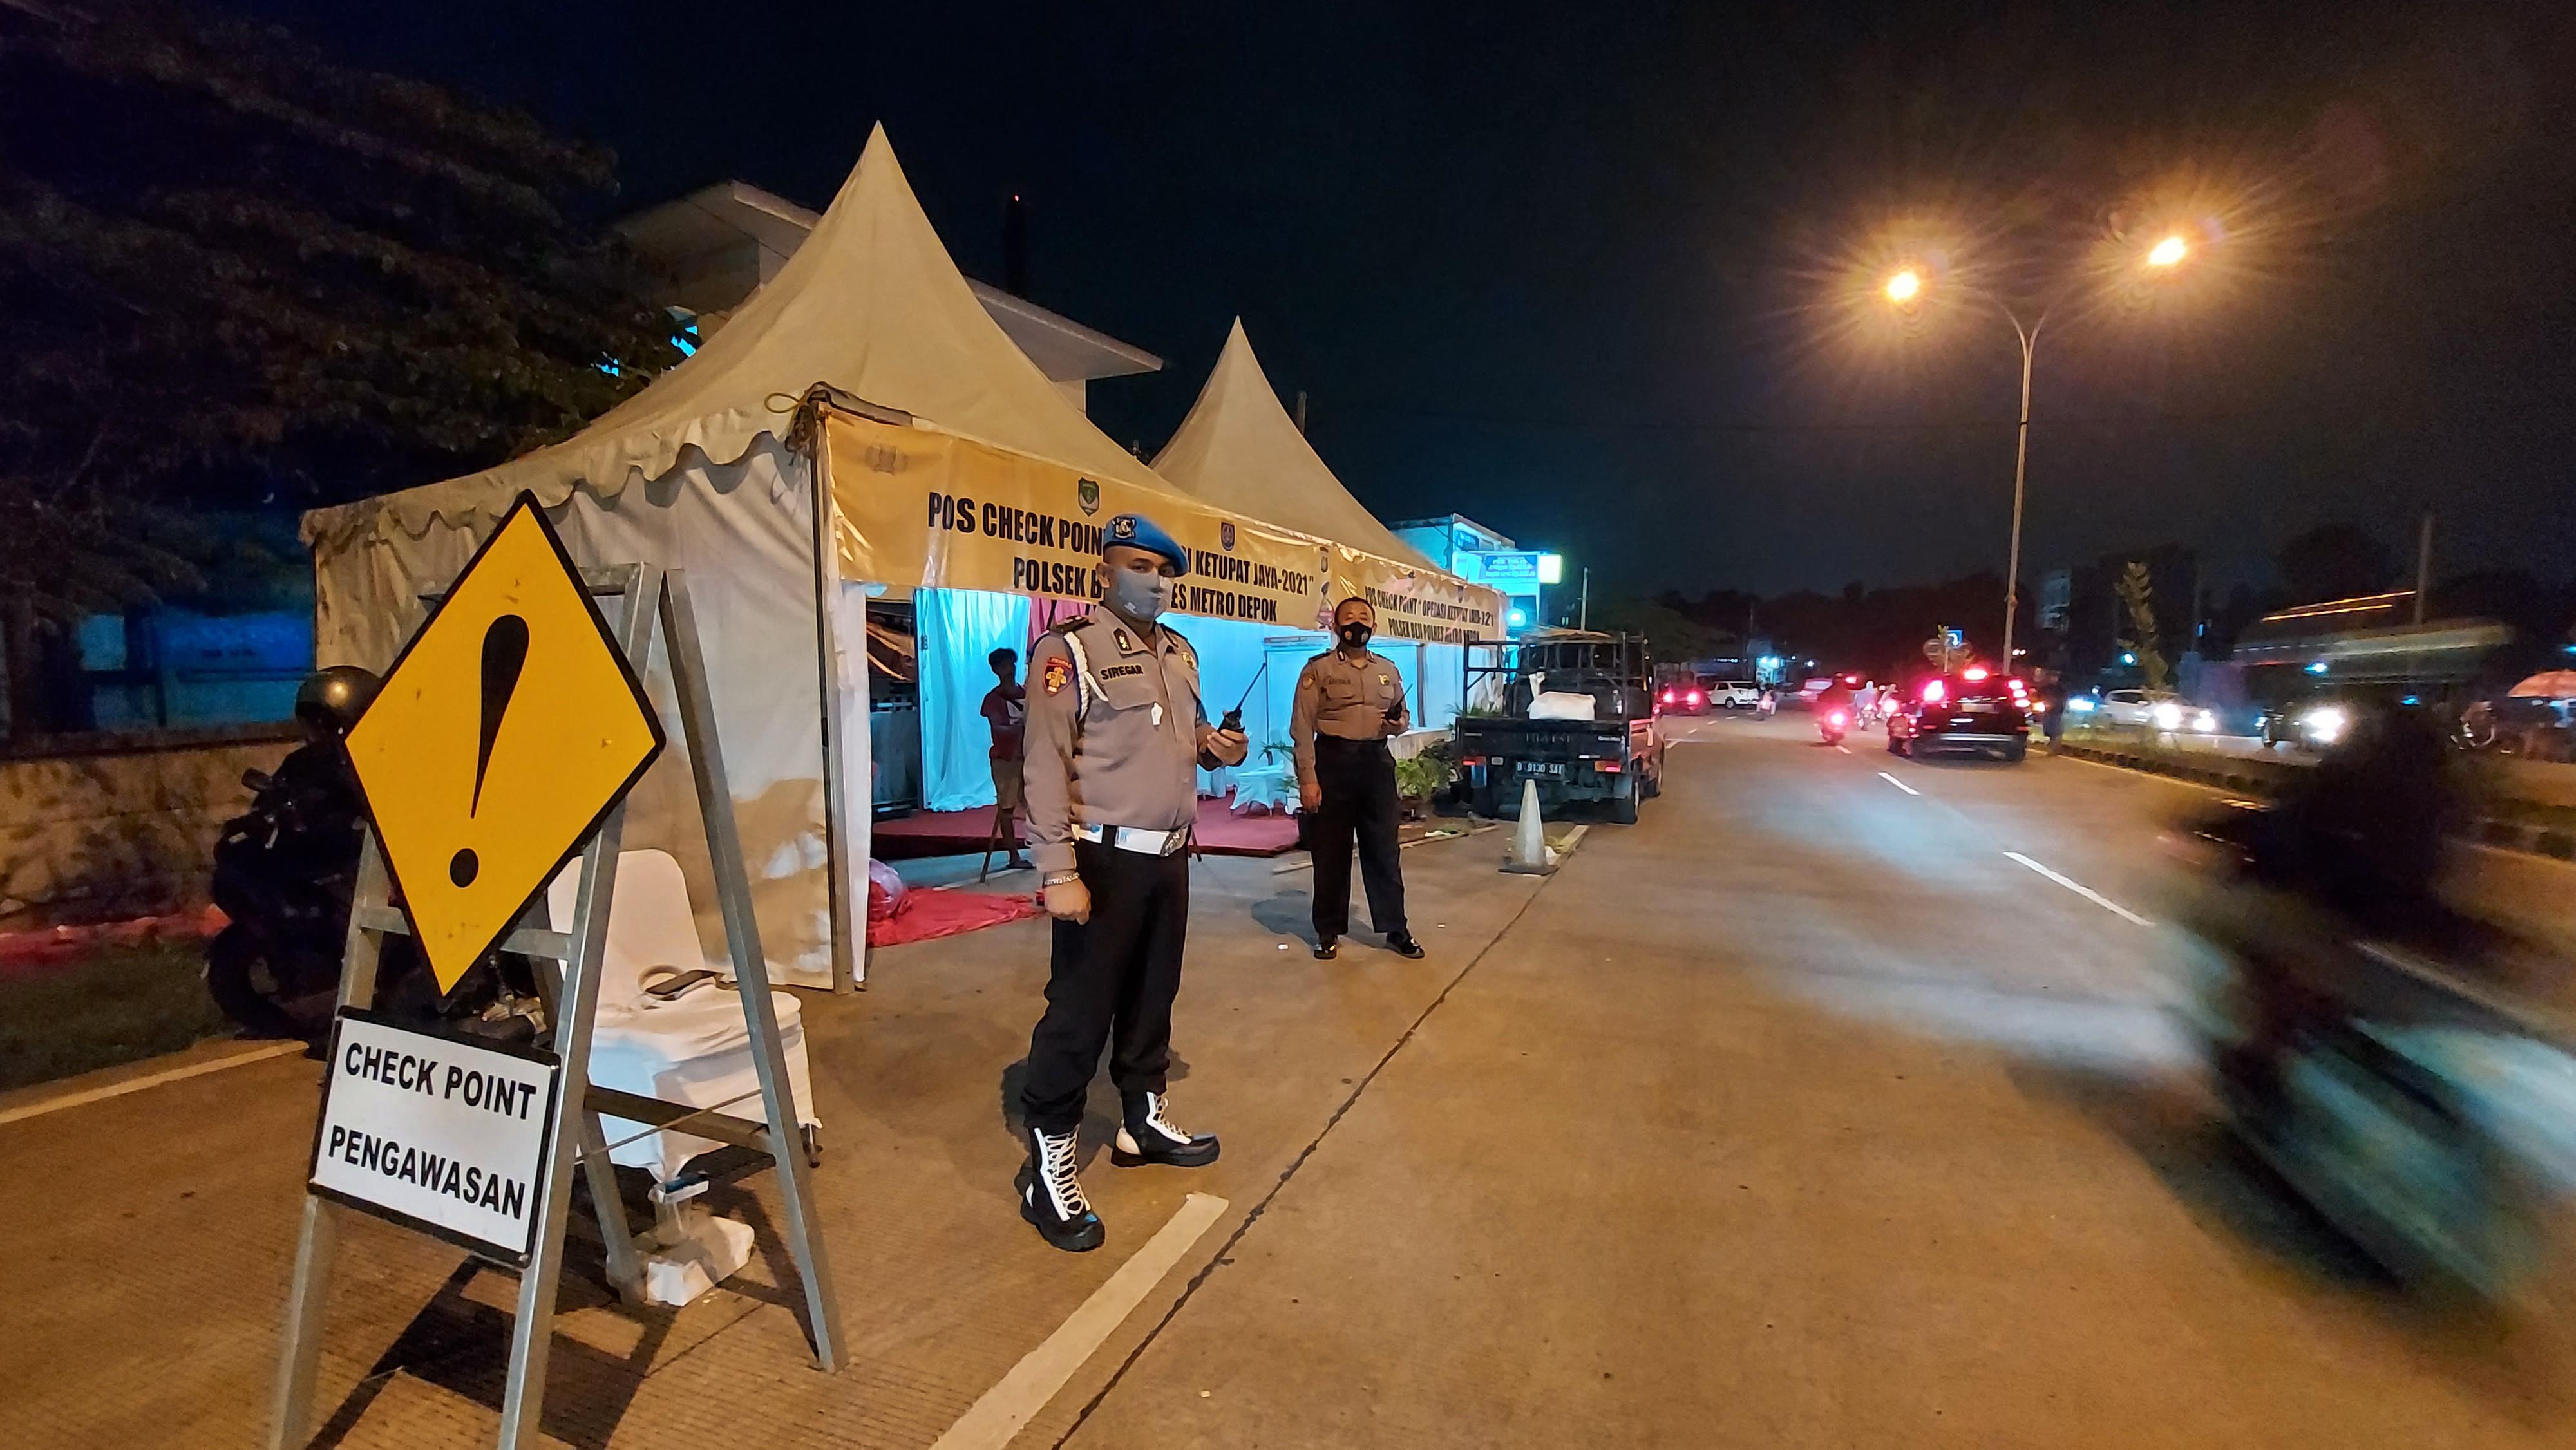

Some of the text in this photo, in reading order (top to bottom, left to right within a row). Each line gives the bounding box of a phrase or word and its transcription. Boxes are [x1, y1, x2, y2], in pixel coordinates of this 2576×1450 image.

[928, 491, 976, 534] POS
[982, 502, 1054, 547] CHECK
[1059, 518, 1105, 556] POIN
[1195, 549, 1250, 584] KETUPAT
[1014, 556, 1087, 598] POLSEK
[1190, 586, 1235, 616] METRO
[1238, 594, 1277, 622] DEPOK
[1377, 589, 1398, 612] CHECK
[1399, 594, 1418, 615] POINT
[1100, 664, 1144, 681] SIREGAR
[345, 1042, 536, 1120] CHECK POINT
[328, 1125, 526, 1220] PENGAWASAN
